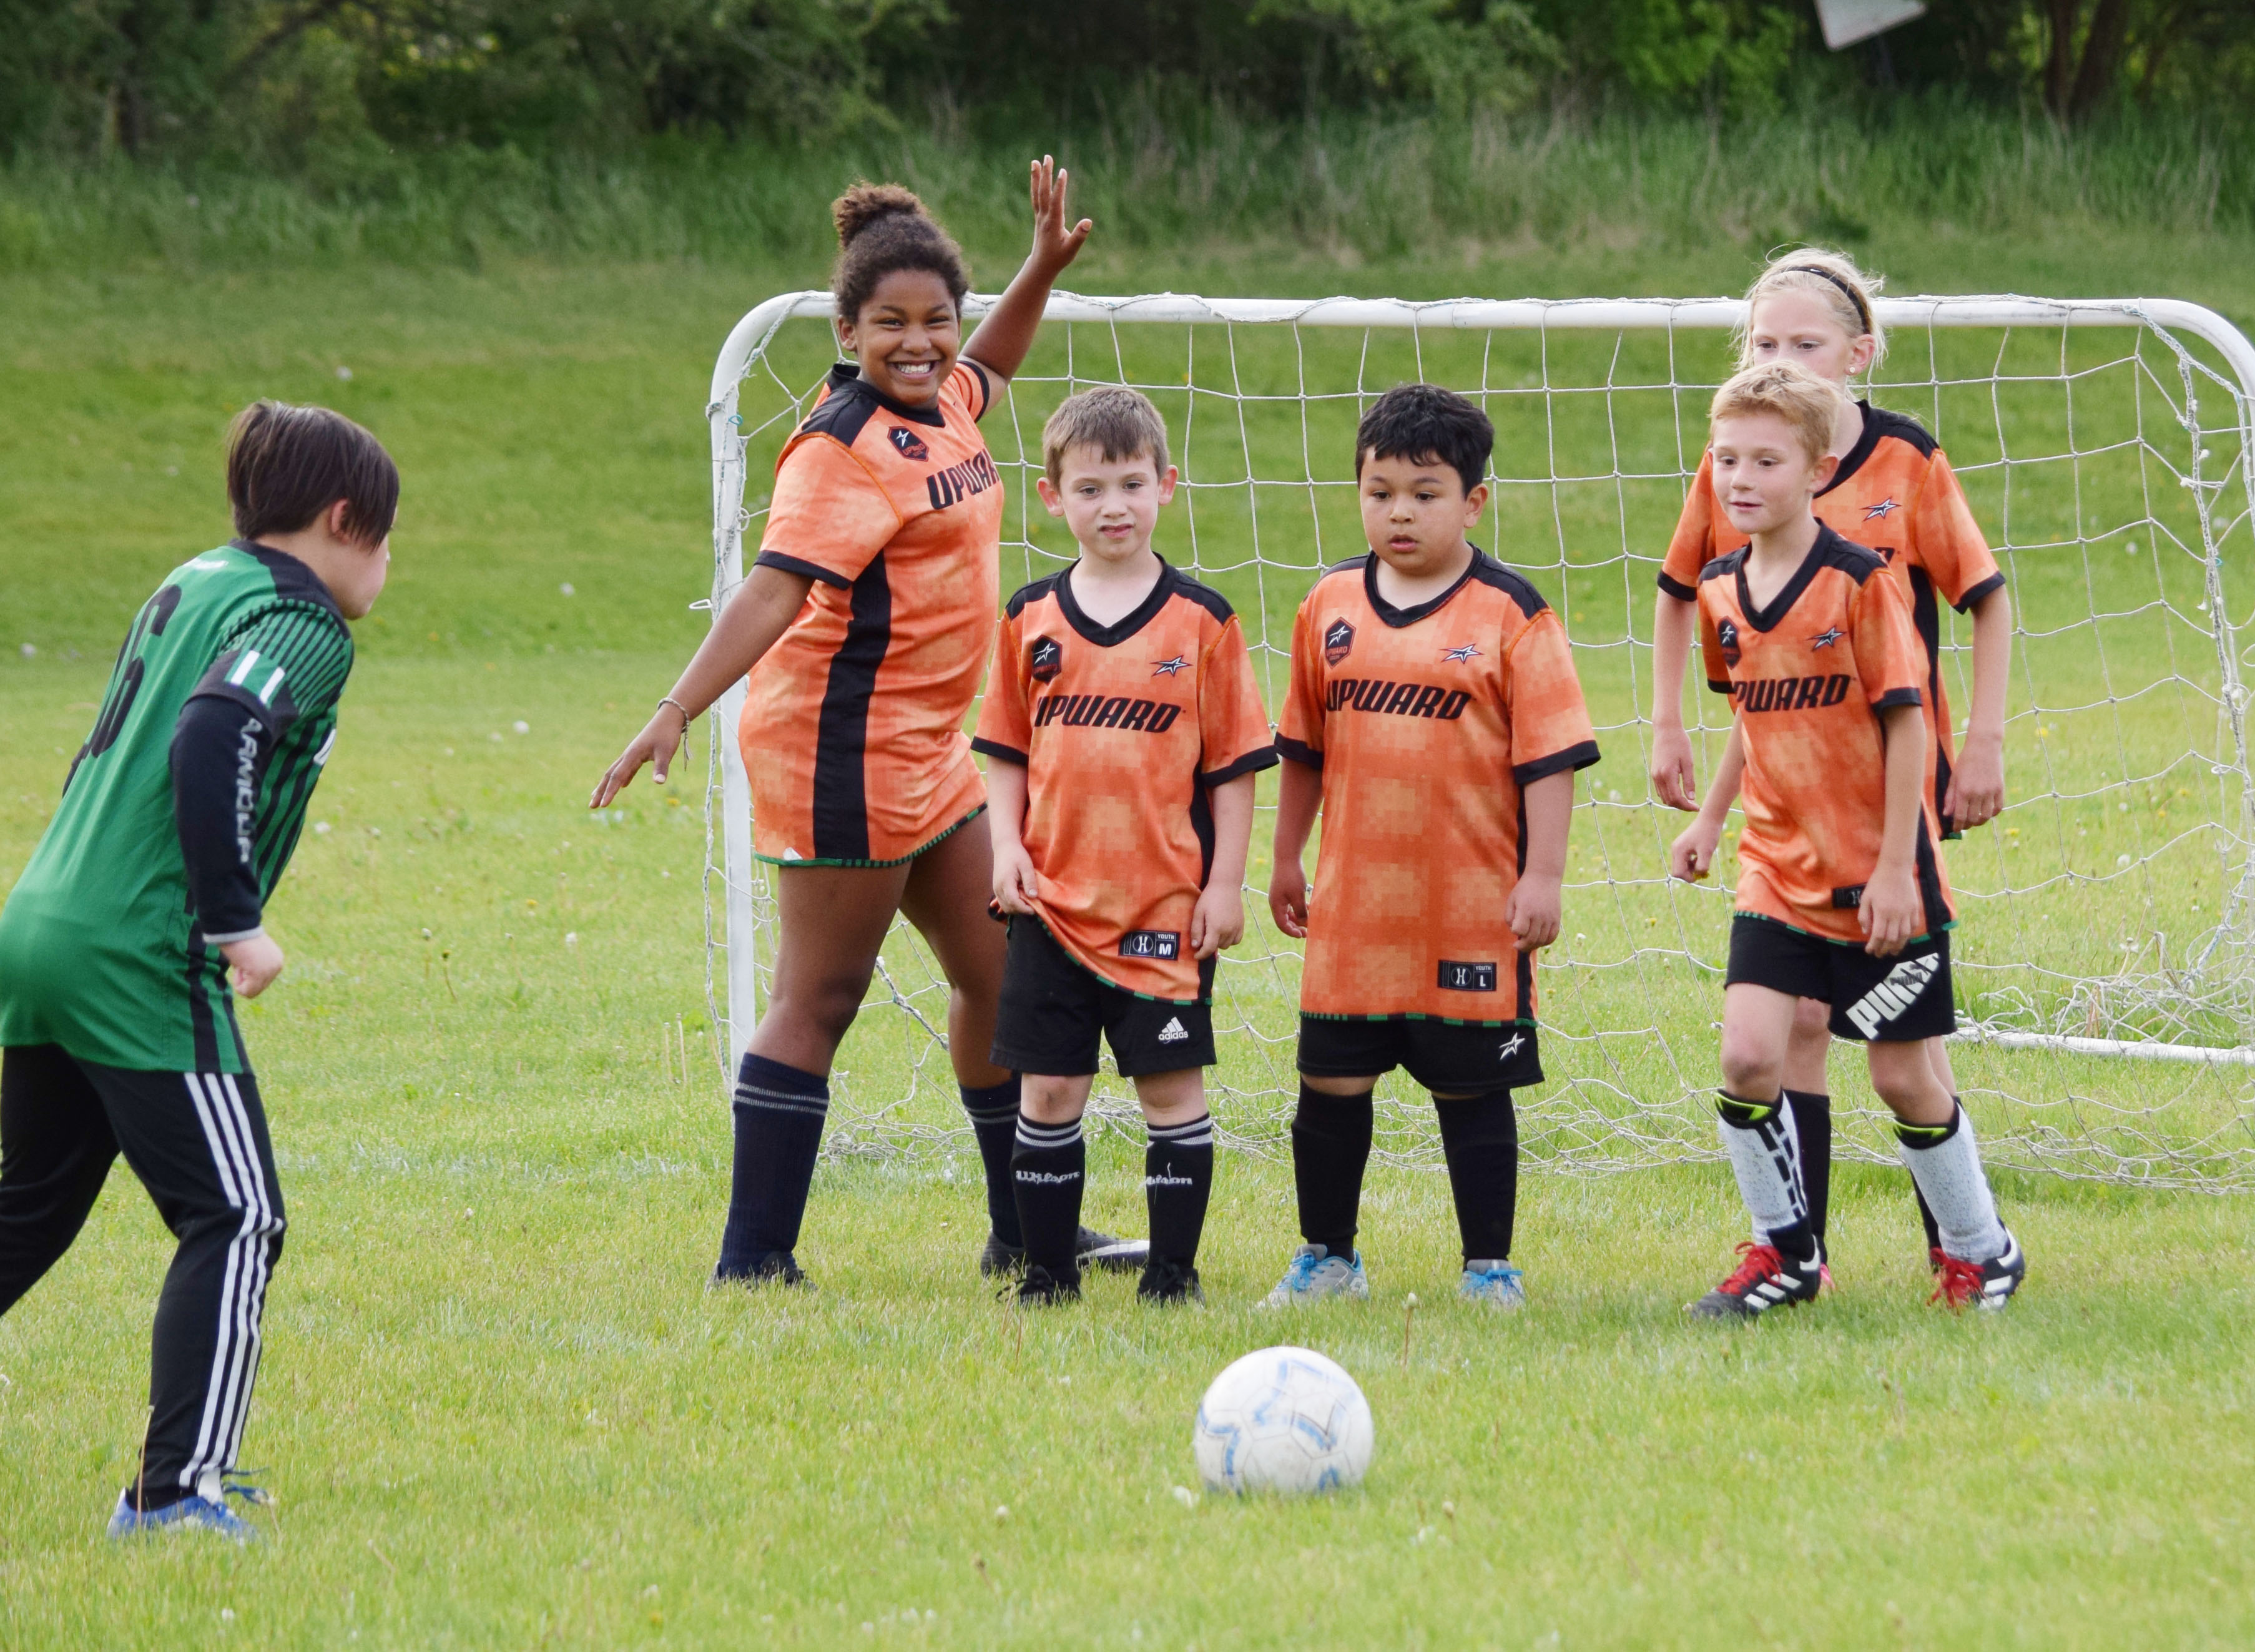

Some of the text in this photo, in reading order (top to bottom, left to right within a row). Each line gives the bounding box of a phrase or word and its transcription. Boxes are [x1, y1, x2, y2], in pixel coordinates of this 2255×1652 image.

[926, 448, 1000, 510] UPWAR
[1326, 679, 1472, 720] UPWARD
[1733, 674, 1851, 713] PWARD
[1159, 943, 1172, 956] M
[1480, 974, 1486, 987] L
[1158, 1031, 1189, 1041] adidas
[1016, 1170, 1080, 1184] Wilson
